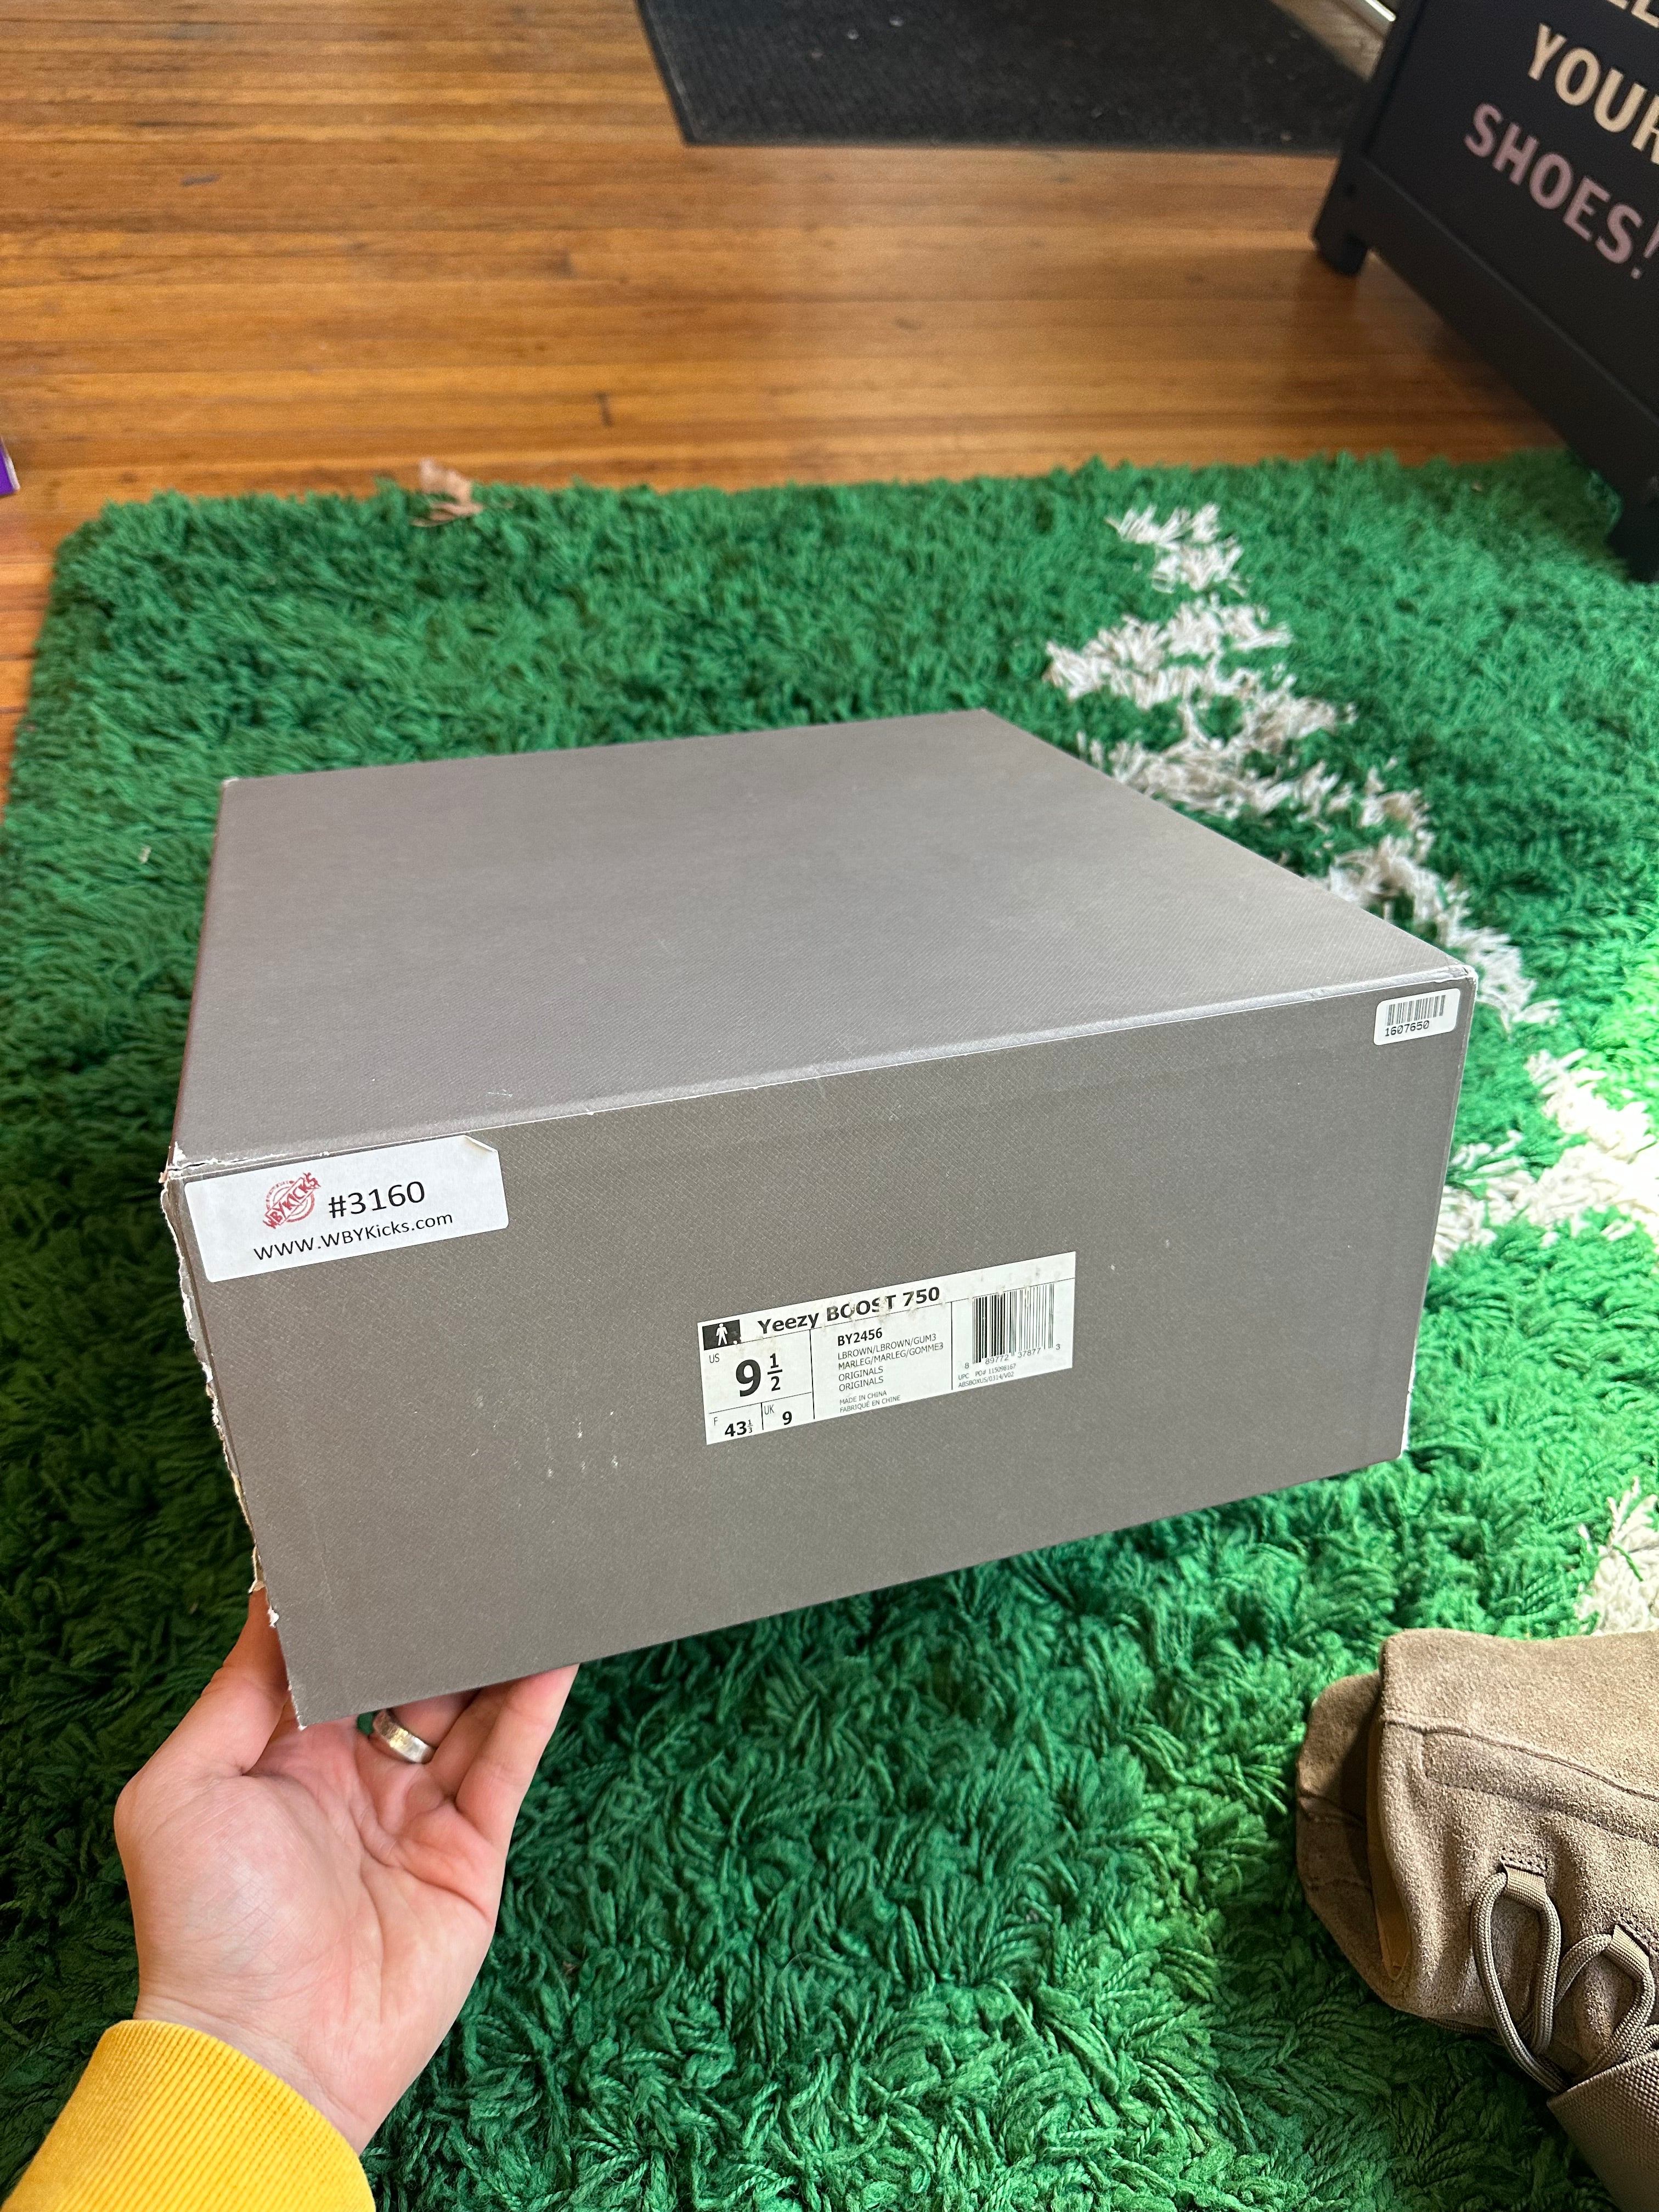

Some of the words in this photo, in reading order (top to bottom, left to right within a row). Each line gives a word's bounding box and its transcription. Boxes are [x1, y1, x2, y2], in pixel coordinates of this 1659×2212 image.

[1385, 1020, 1430, 1037] 1607650
[328, 1181, 425, 1218] #3160
[757, 1312, 820, 1334] Yeezy
[902, 1286, 940, 1307] 750
[837, 1327, 883, 1346] BY2456
[838, 1333, 936, 1360] LBROWN/LBROWN/GUM3
[709, 1353, 720, 1363] US
[838, 1342, 944, 1370] MARLEG/MARLEG/GOMME3
[985, 1354, 1009, 1365] 89772
[1017, 1347, 1041, 1358] 37877
[736, 1359, 761, 1397] 9
[838, 1365, 883, 1381] ORIGINALS
[839, 1375, 884, 1392] ORIGINALS
[839, 1396, 857, 1405] MADE
[867, 1390, 887, 1399] CHINA
[882, 1395, 901, 1404] CHINE
[764, 1404, 775, 1415] UK
[782, 1411, 792, 1425] 9
[714, 1417, 718, 1426] F
